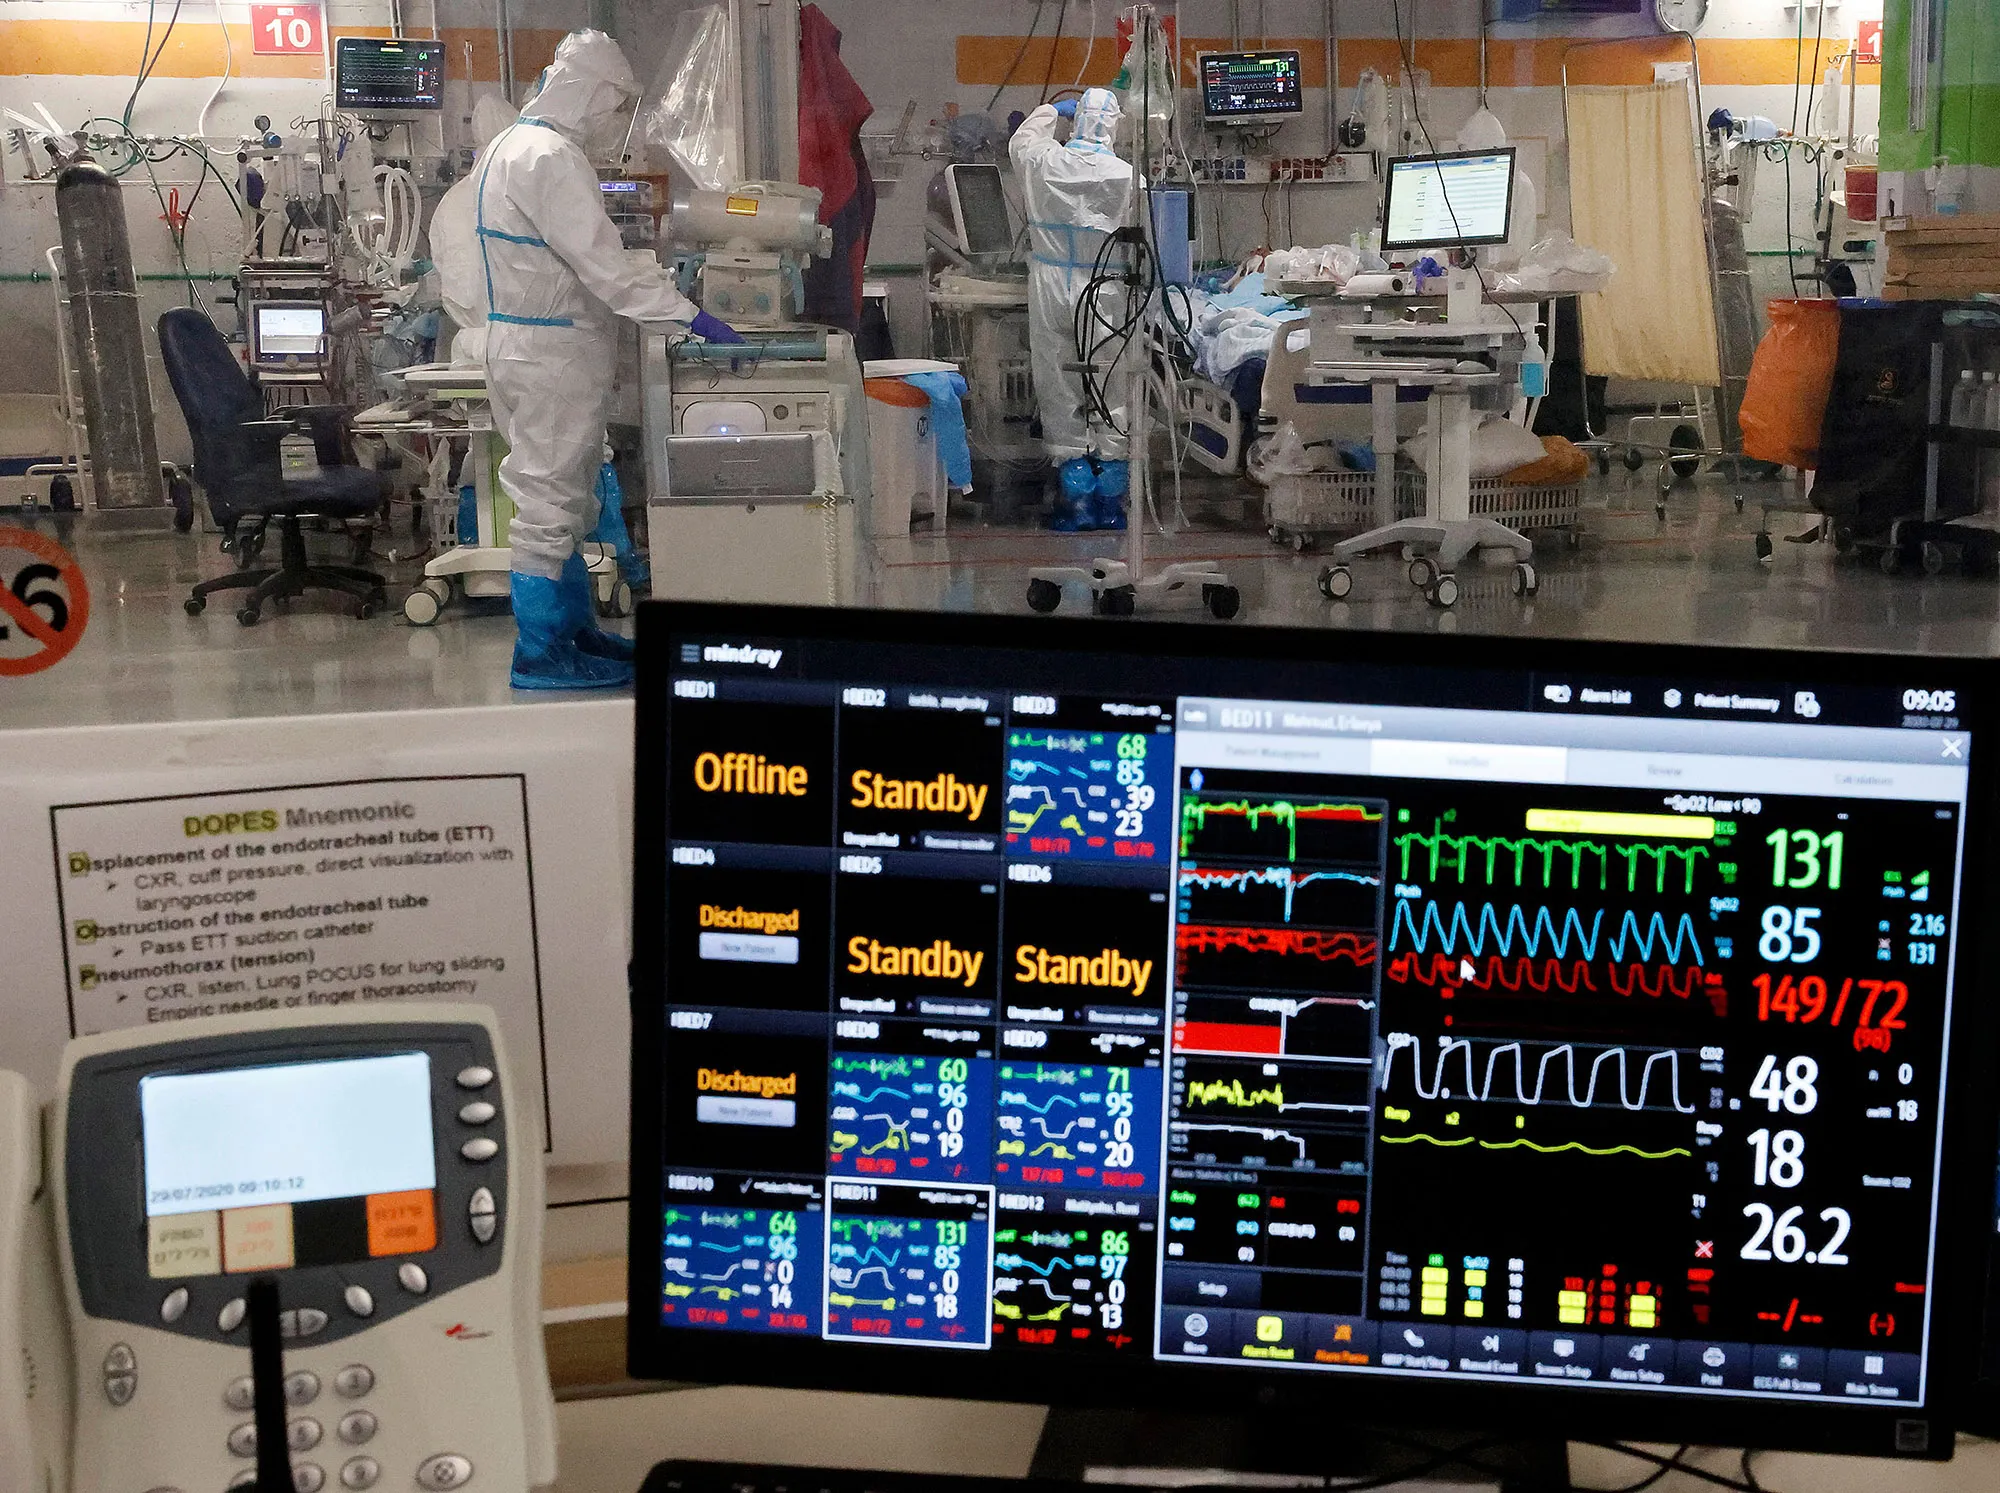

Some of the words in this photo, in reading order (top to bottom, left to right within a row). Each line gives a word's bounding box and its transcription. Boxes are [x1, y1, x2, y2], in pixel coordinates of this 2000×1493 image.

[265, 18, 312, 48] 10
[704, 644, 782, 669] mindray
[1903, 689, 1956, 713] 09:05
[1116, 733, 1148, 760] 68
[695, 752, 809, 797] Offline
[1116, 760, 1146, 786] 85
[851, 770, 989, 821] Standby
[1125, 784, 1156, 812] 39
[184, 810, 278, 837] DOPES
[286, 803, 415, 828] Mnemonic
[1114, 810, 1144, 837] 23
[69, 849, 205, 873] Displacement
[211, 844, 229, 860] of
[235, 842, 265, 857] the
[272, 830, 393, 853] endotracheal
[399, 828, 440, 843] tube
[445, 825, 494, 845] (ETT)
[1766, 827, 1844, 890] 131
[189, 867, 221, 885] cuff
[316, 856, 364, 873] direct
[370, 850, 474, 867] visualization
[480, 848, 513, 861] with
[136, 889, 256, 912] laryngoscope
[76, 917, 194, 940] Obstruction
[200, 912, 219, 928] of
[224, 910, 254, 925] the
[261, 897, 383, 921] endotracheal
[388, 894, 428, 909] tube
[700, 905, 800, 935] Discharged
[141, 939, 186, 956] Pass
[192, 933, 228, 951] ETT
[235, 929, 298, 947] suction
[304, 922, 374, 940] catheter
[1758, 904, 1822, 964] 85
[80, 959, 224, 982] Pneumothorax
[231, 948, 315, 972] (tension)
[848, 936, 984, 988] Standby
[1907, 941, 1936, 965] 131
[257, 973, 300, 990] Lung
[306, 963, 376, 984] POCUS
[380, 962, 403, 976] for
[408, 960, 445, 975] lung
[450, 956, 505, 972] sliding
[1015, 945, 1153, 996] Standby
[147, 1003, 214, 1023] Empiric
[220, 996, 278, 1013] needle
[285, 995, 303, 1008] or
[308, 989, 355, 1006] finger
[362, 980, 476, 999] thoracostomy
[1752, 972, 1909, 1030] 149/72
[698, 1068, 797, 1099] Discharged
[938, 1058, 968, 1083] 60
[1106, 1067, 1131, 1092] 71
[1897, 1062, 1913, 1085] 0
[937, 1083, 968, 1108] 96
[1749, 1054, 1819, 1115] 48
[1105, 1092, 1134, 1117] 95
[1896, 1099, 1919, 1122] 18
[946, 1108, 964, 1132] 0
[1114, 1117, 1132, 1143] 0
[937, 1132, 964, 1158] 19
[1103, 1142, 1135, 1168] 20
[1746, 1127, 1806, 1189] 18
[769, 1211, 797, 1235] 64
[935, 1220, 968, 1246] 131
[1739, 1202, 1852, 1266] 26.2
[1101, 1230, 1130, 1255] 86
[934, 1245, 961, 1270] 85
[1099, 1255, 1129, 1281] 97
[778, 1260, 794, 1283] 0
[942, 1269, 959, 1294] 0
[769, 1283, 793, 1309] 14
[1109, 1280, 1127, 1304] 0
[934, 1293, 959, 1319] 18
[1099, 1304, 1124, 1329] 13
